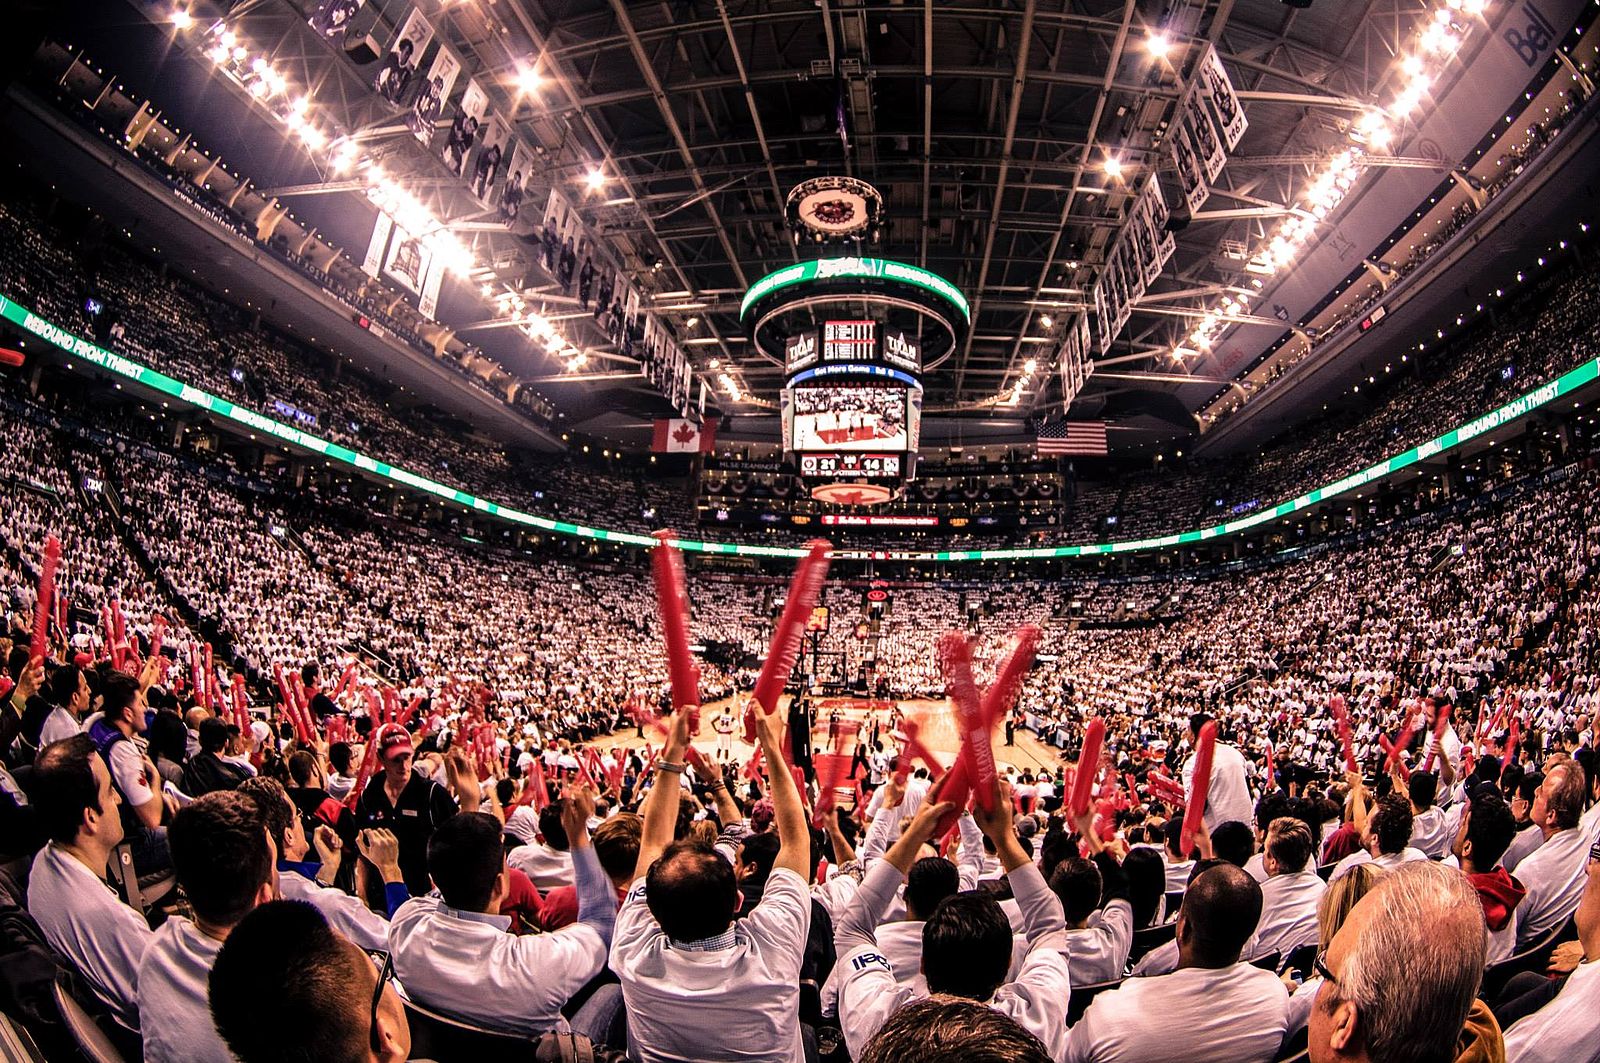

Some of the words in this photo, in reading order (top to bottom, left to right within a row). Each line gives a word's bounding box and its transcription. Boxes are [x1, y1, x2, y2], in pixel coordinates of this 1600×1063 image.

[1503, 0, 1557, 68] Bell
[1229, 117, 1243, 143] 1967
[24, 313, 74, 350] REBOUND
[73, 340, 106, 364] FROM
[106, 353, 144, 380] THIRST
[887, 332, 917, 360] TITAN
[1457, 412, 1499, 442] REBOUND
[1499, 399, 1526, 423] FROM
[1526, 381, 1559, 410] THIRST
[820, 459, 836, 470] 21
[864, 459, 880, 470] 14
[852, 953, 891, 971] Bell
